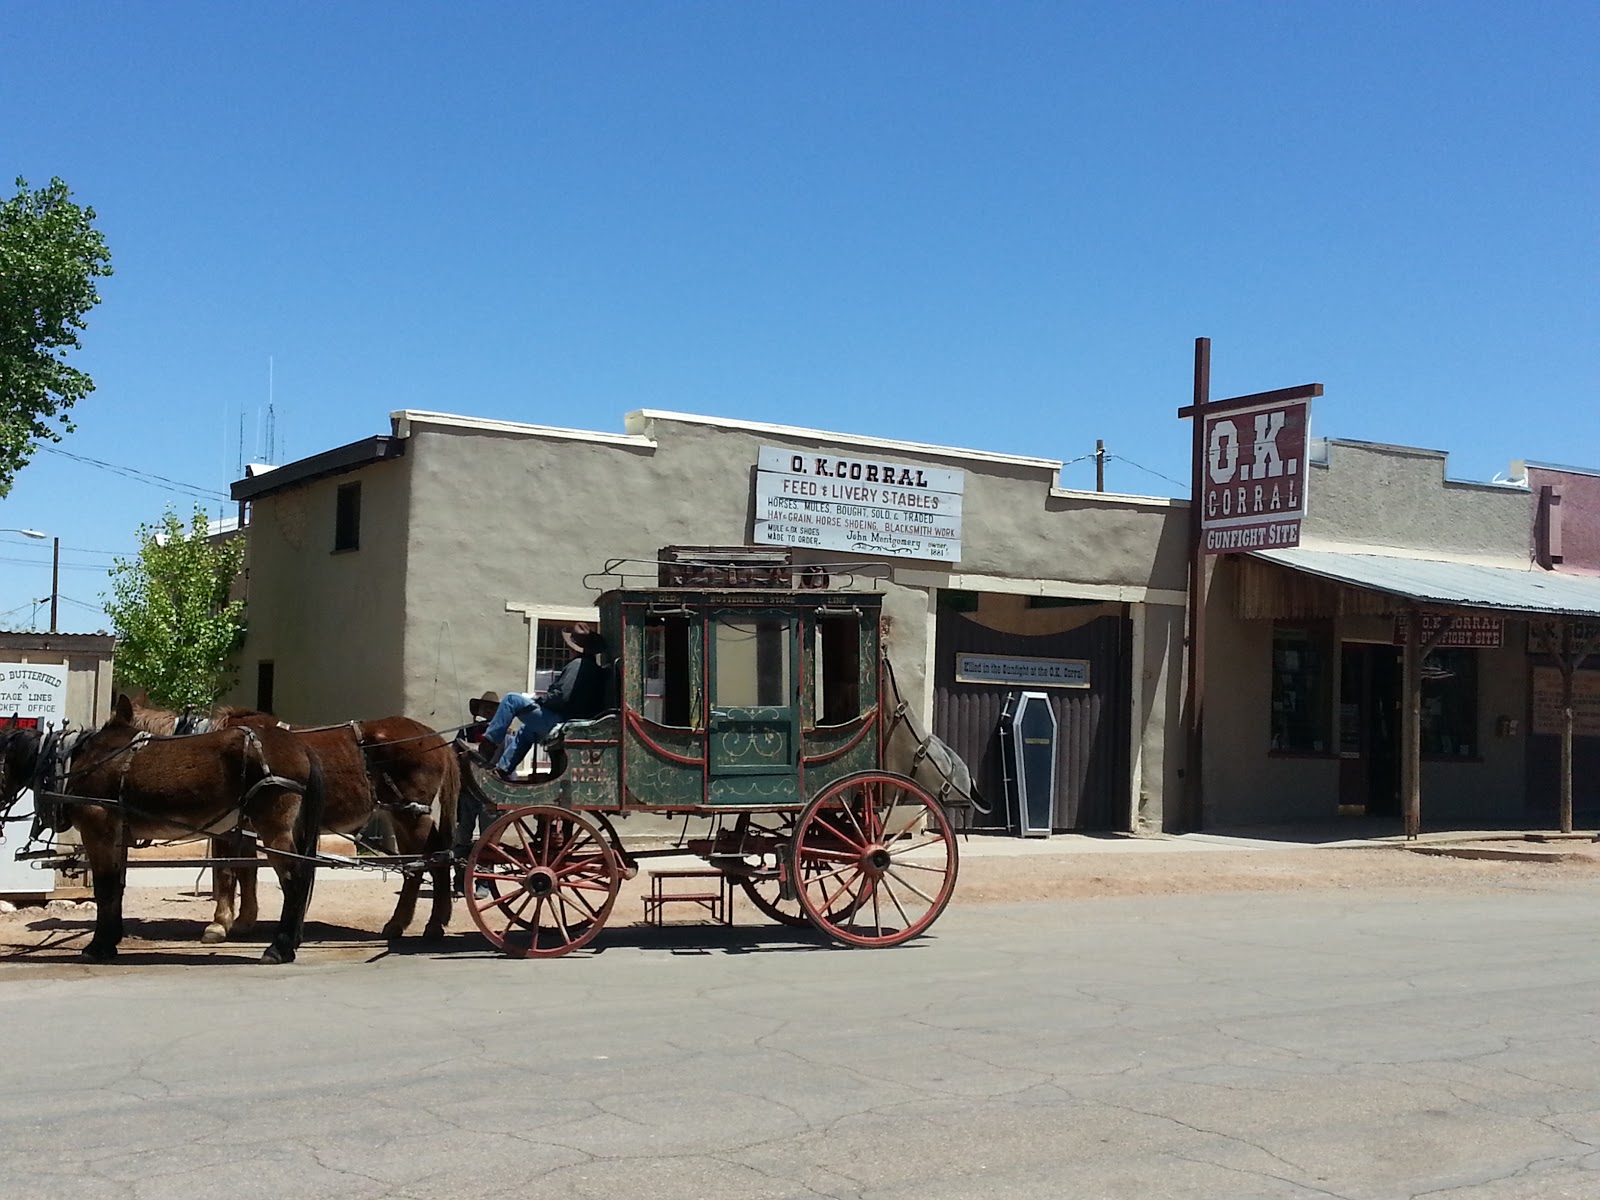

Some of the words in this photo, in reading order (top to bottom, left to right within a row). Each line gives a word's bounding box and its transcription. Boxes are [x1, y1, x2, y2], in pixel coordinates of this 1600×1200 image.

[1208, 411, 1298, 485] O.K.
[783, 479, 817, 496] FEED
[831, 484, 878, 502] LIVERY
[882, 490, 939, 509] STABLES
[1208, 480, 1298, 517] CORRAL
[816, 515, 842, 527] HORSE
[884, 522, 932, 536] BLACKSMITH
[934, 527, 955, 537] WORK
[903, 511, 934, 524] TRADED
[767, 523, 783, 532] MULE
[800, 527, 820, 536] SHOES
[767, 532, 784, 541] MADE
[787, 534, 796, 543] TO
[1207, 527, 1266, 550] GUNFIGHT
[1269, 524, 1298, 545] SITE
[846, 530, 867, 541] John
[871, 532, 921, 550] Montgomery
[1475, 632, 1500, 645] SITE
[9, 670, 62, 688] BUTTERFIELD
[0, 692, 23, 701] TAGE
[28, 693, 52, 702] LINES
[28, 704, 56, 713] OFFICE
